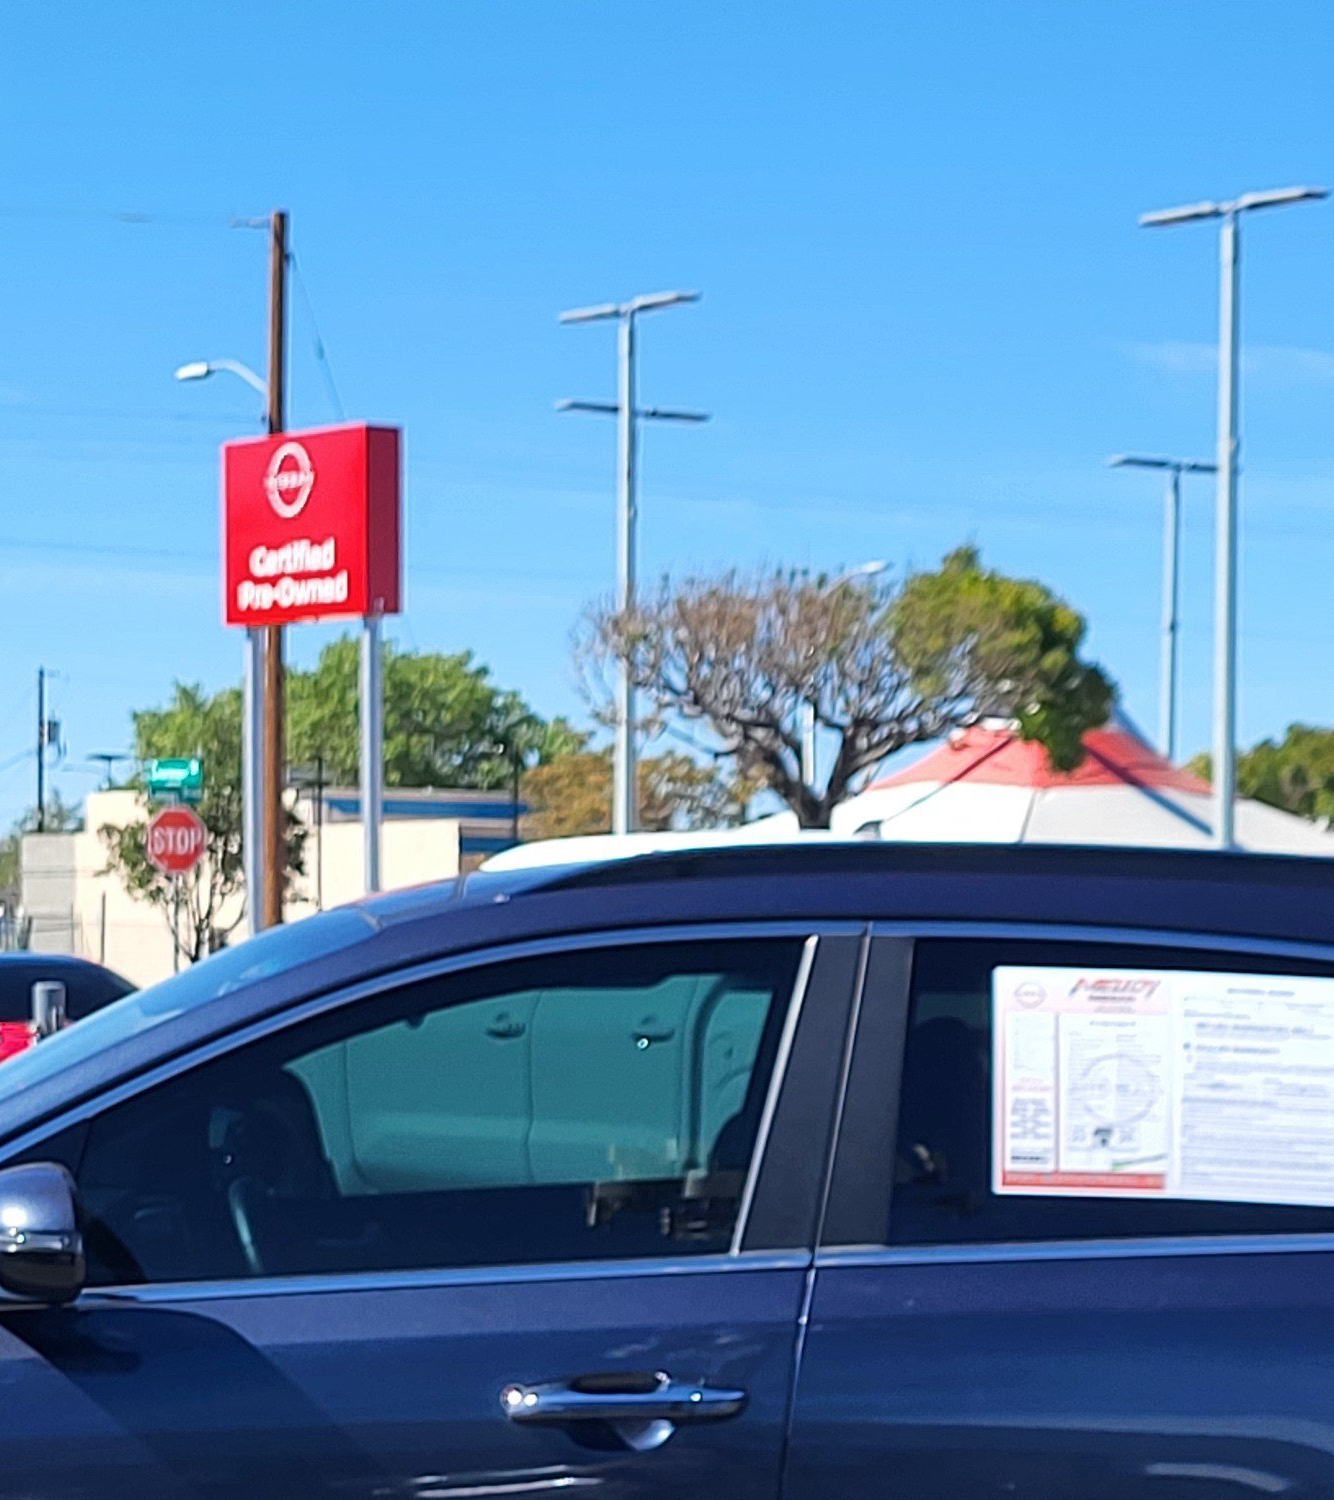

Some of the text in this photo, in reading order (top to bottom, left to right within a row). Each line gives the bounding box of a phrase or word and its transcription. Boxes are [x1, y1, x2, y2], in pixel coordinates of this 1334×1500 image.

[249, 536, 334, 577] Certified
[236, 569, 348, 612] Pre-Owned
[154, 827, 203, 855] STOP
